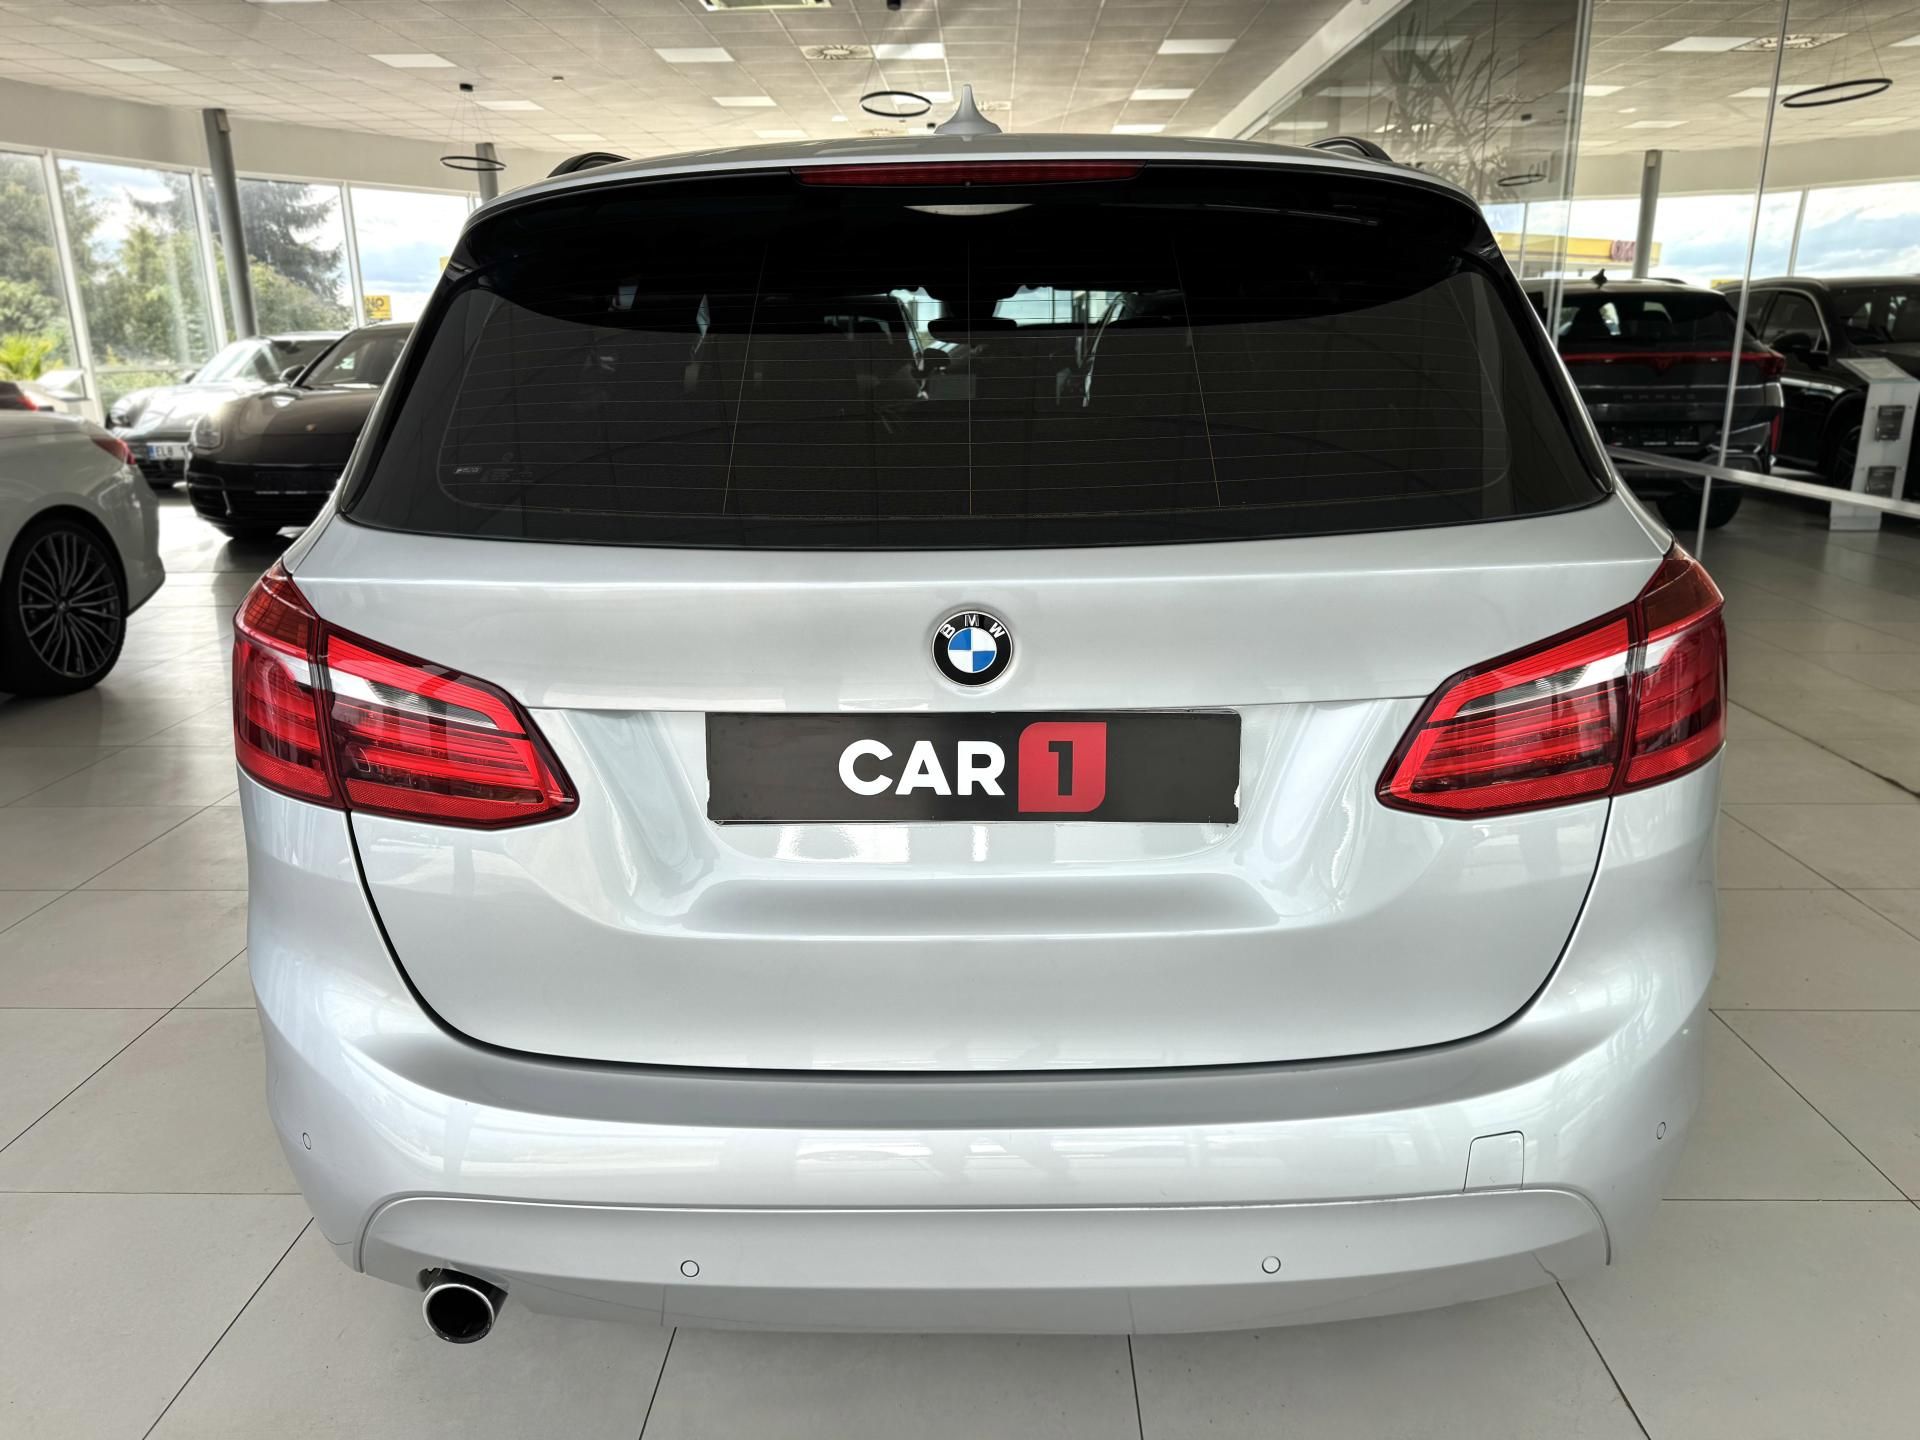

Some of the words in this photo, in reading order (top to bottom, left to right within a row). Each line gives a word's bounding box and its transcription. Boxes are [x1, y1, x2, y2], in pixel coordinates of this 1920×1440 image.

[939, 614, 1006, 639] BMW
[838, 738, 1006, 796] CAR
[1048, 740, 1073, 796] 1
